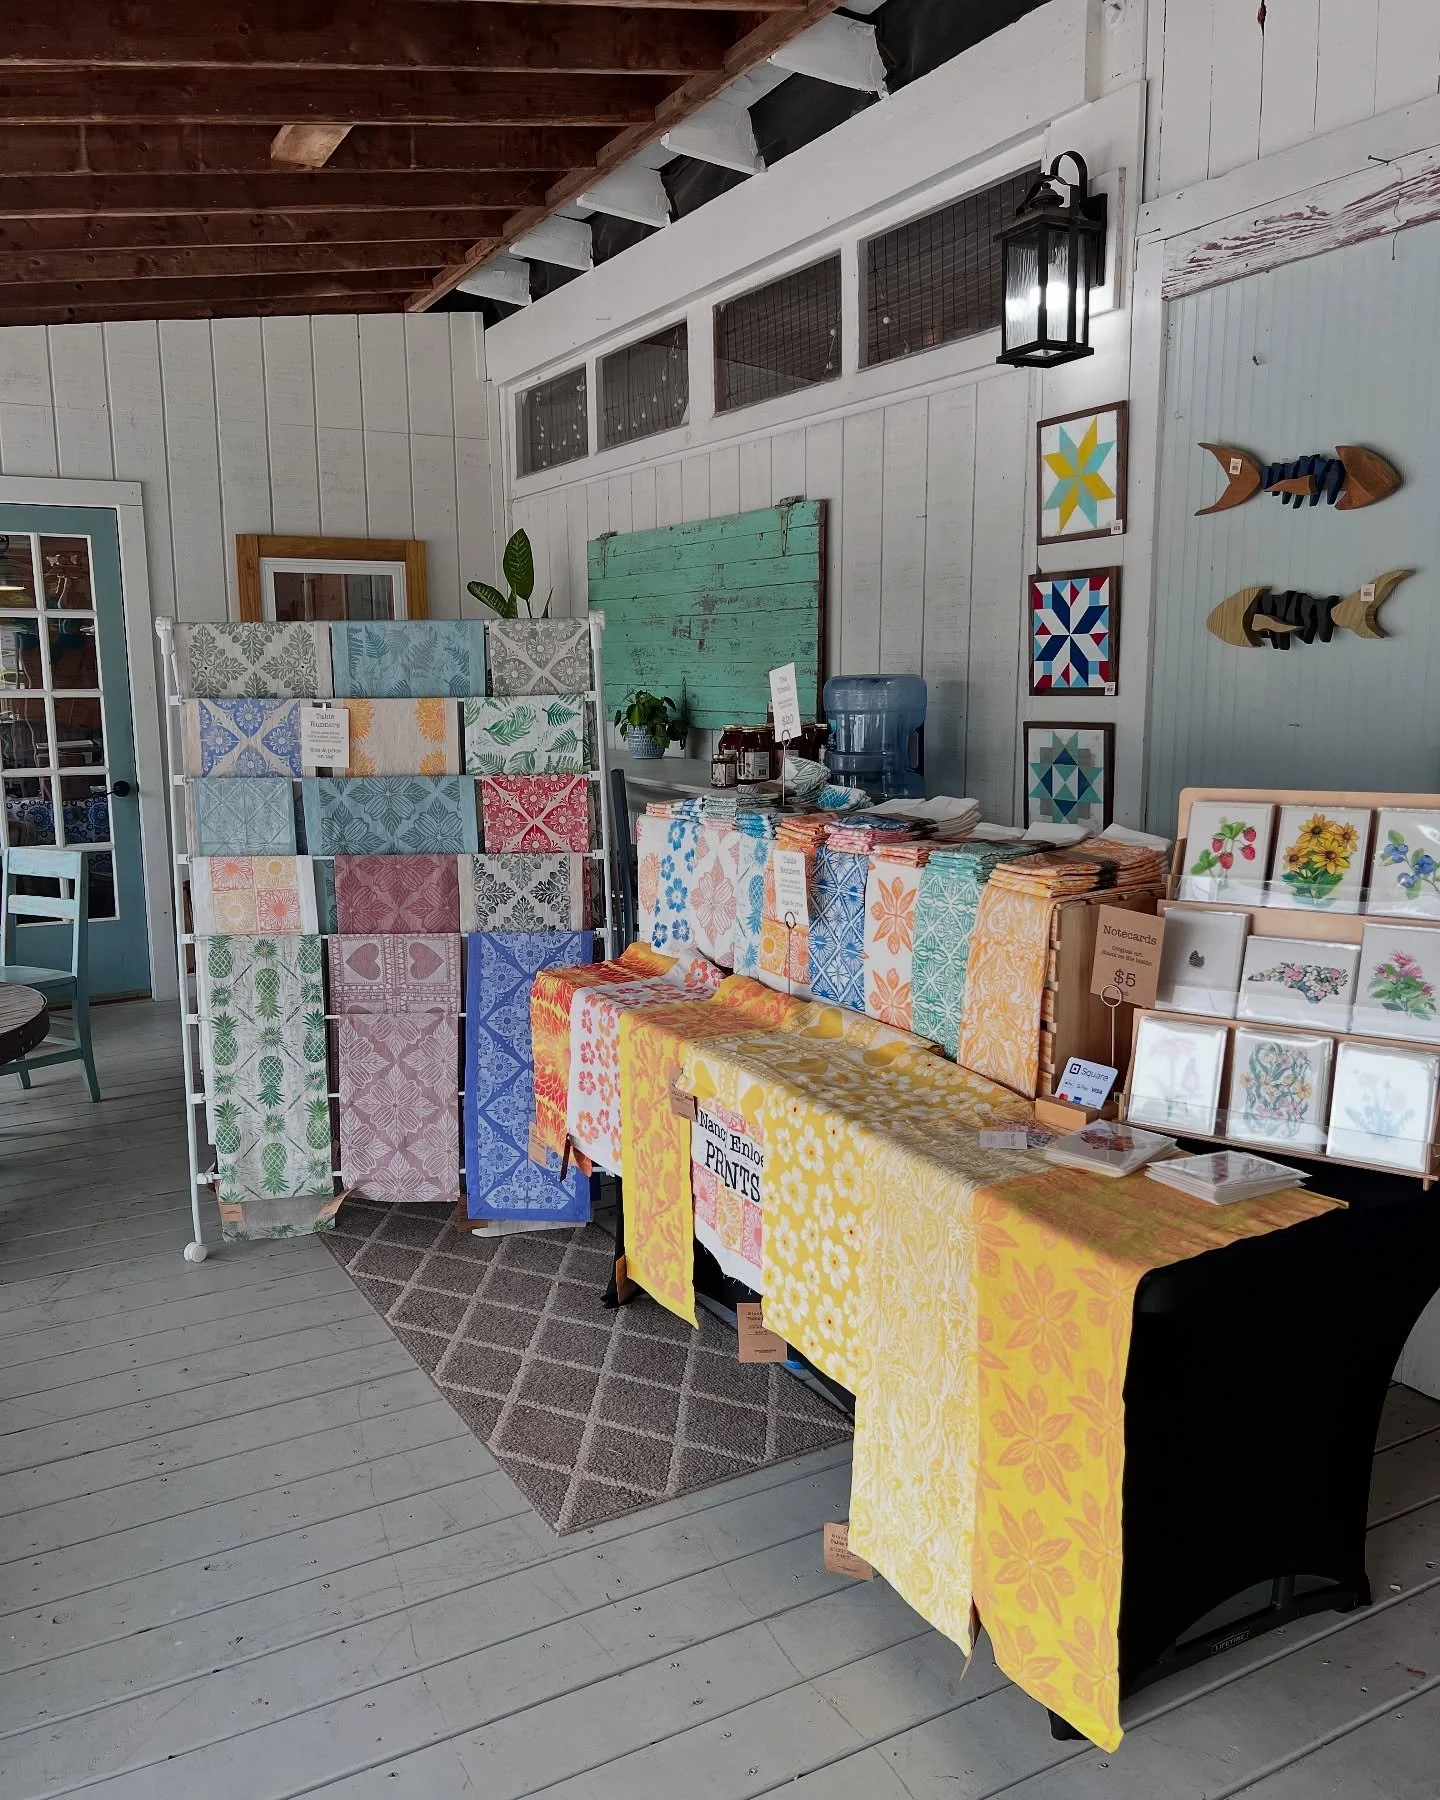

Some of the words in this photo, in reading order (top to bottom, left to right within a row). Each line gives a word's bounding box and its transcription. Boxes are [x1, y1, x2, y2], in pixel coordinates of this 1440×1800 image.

[310, 720, 341, 729] Runners
[1102, 924, 1157, 946] Notecards
[1113, 969, 1136, 987] $5
[1081, 1067, 1109, 1081] Square
[699, 1109, 728, 1148] Nanc
[705, 1139, 761, 1202] PRNTS
[1215, 1634, 1245, 1651] LIFETIME
